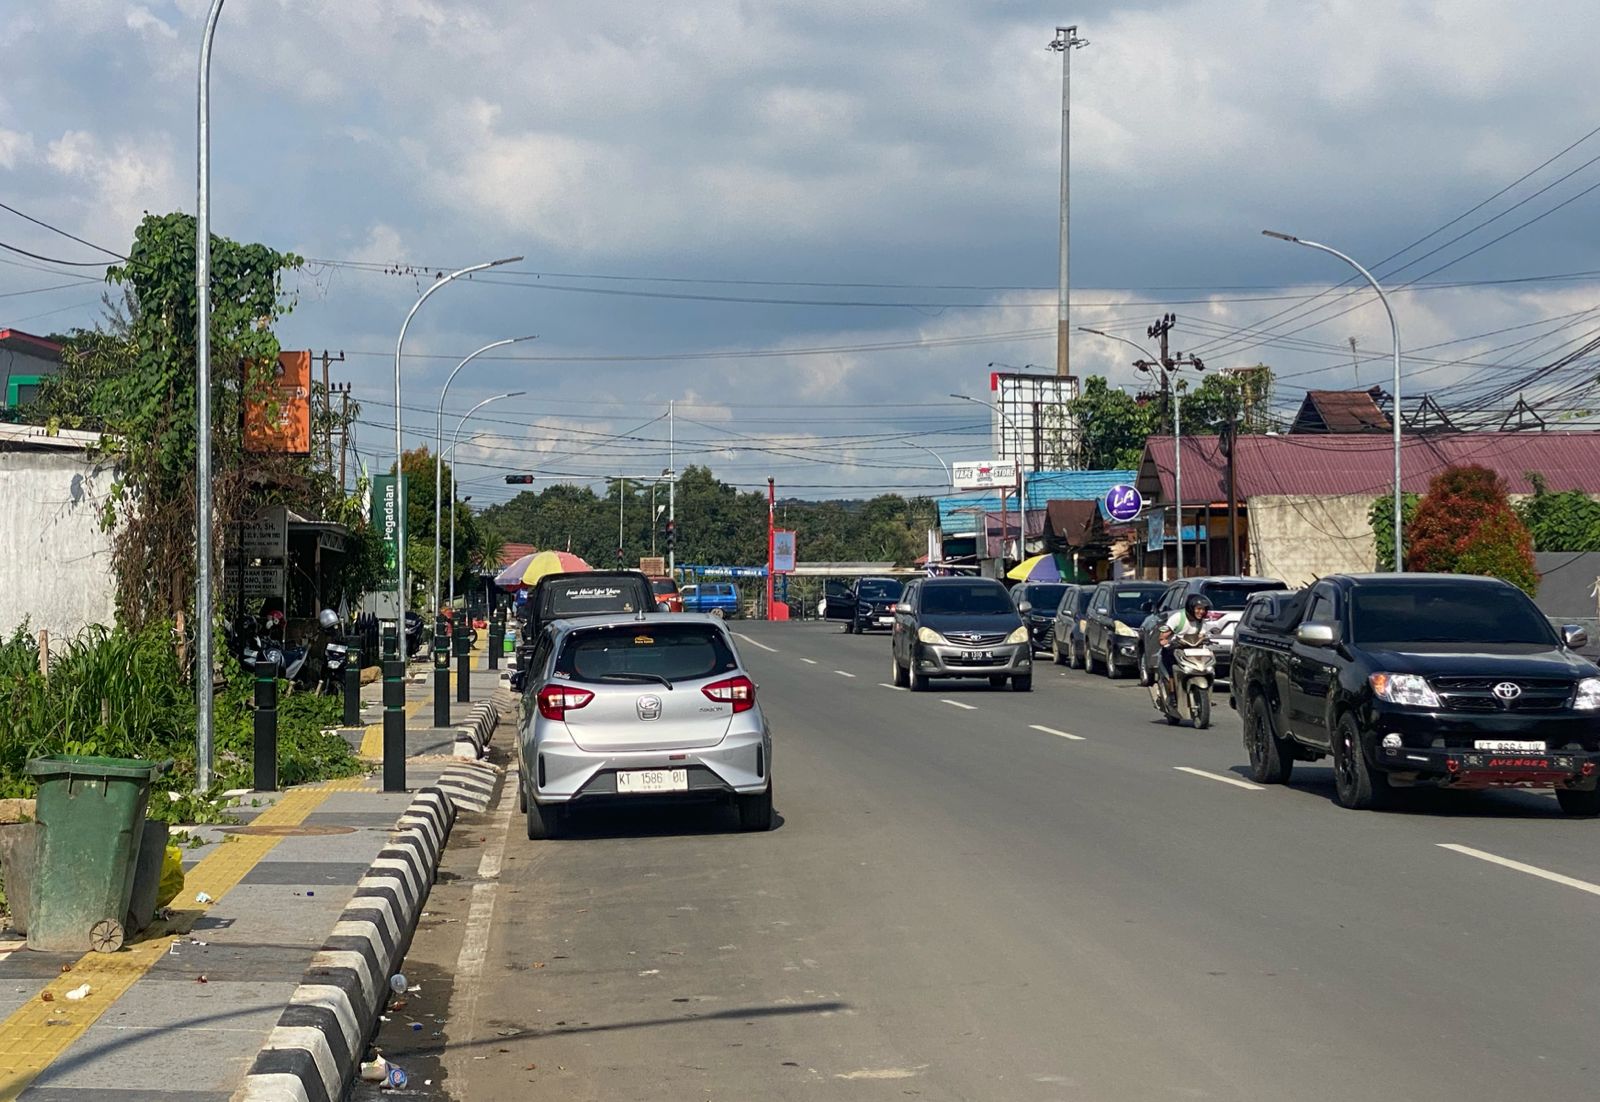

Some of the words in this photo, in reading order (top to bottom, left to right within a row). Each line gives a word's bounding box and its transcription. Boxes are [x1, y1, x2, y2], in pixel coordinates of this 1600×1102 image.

[955, 470, 973, 479] VAPE
[993, 468, 1015, 477] STORE
[383, 484, 396, 540] Pegadaian
[1488, 758, 1549, 768] AVENGER
[619, 773, 631, 785] KT
[641, 772, 663, 784] 1586
